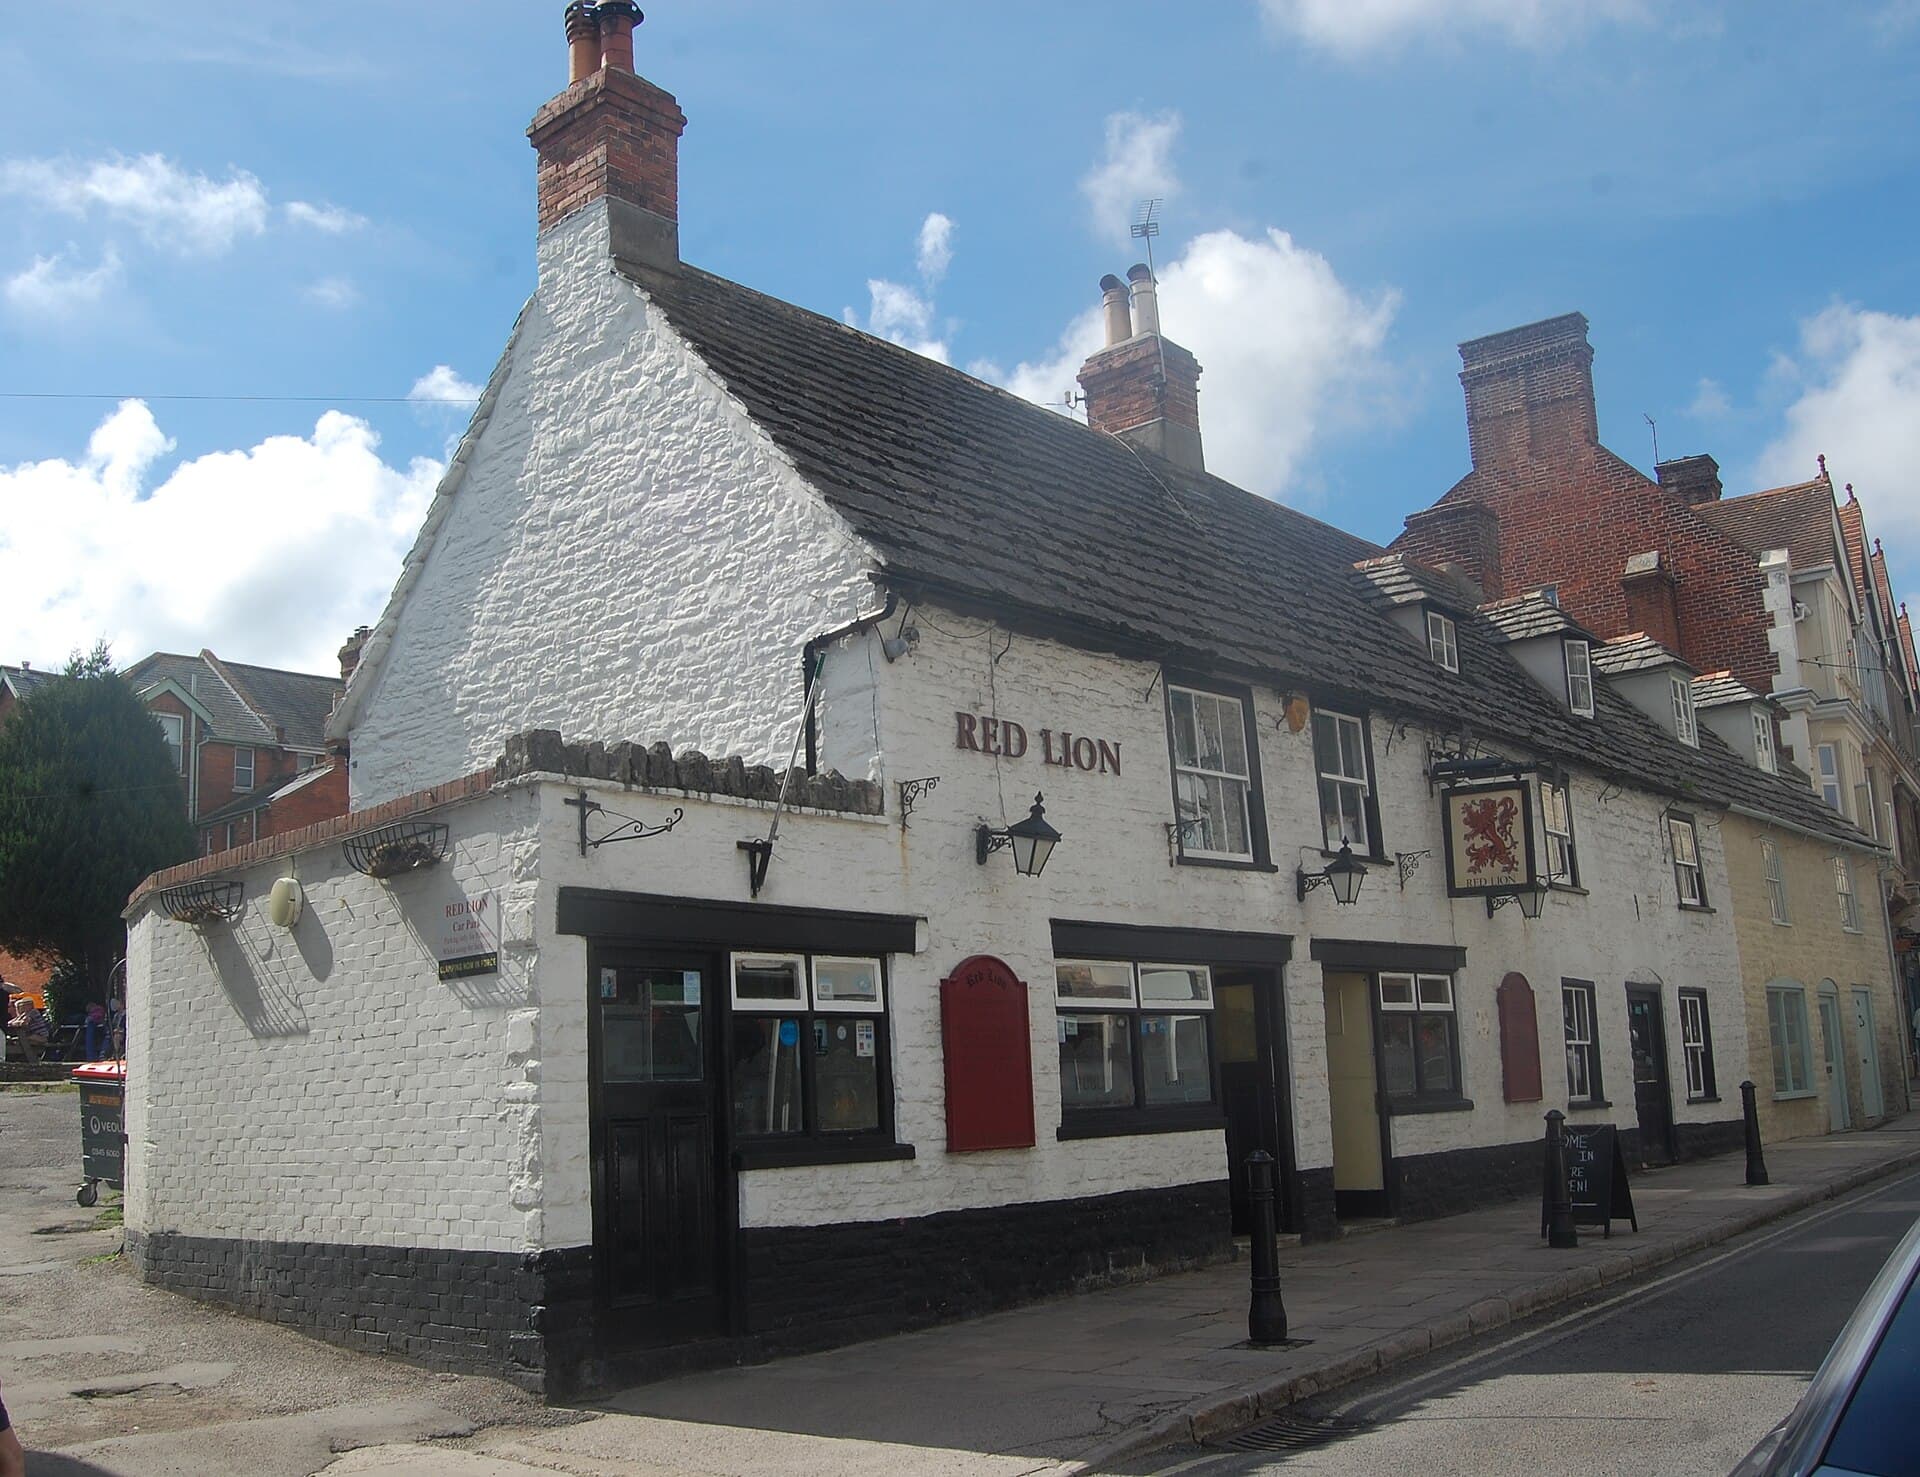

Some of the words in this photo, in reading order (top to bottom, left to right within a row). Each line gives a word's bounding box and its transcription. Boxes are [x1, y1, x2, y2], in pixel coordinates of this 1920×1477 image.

[956, 711, 1028, 758] RED
[1040, 728, 1122, 776] LION
[1466, 877, 1488, 888] RED
[1490, 875, 1516, 886] LION
[446, 903, 464, 917] RED
[466, 897, 488, 913] LION
[453, 921, 465, 932] Car
[967, 970, 984, 987] Red
[101, 1120, 121, 1133] VEOL
[1565, 1135, 1588, 1149] OME
[1579, 1150, 1594, 1162] IN
[1568, 1179, 1587, 1193] EN!
